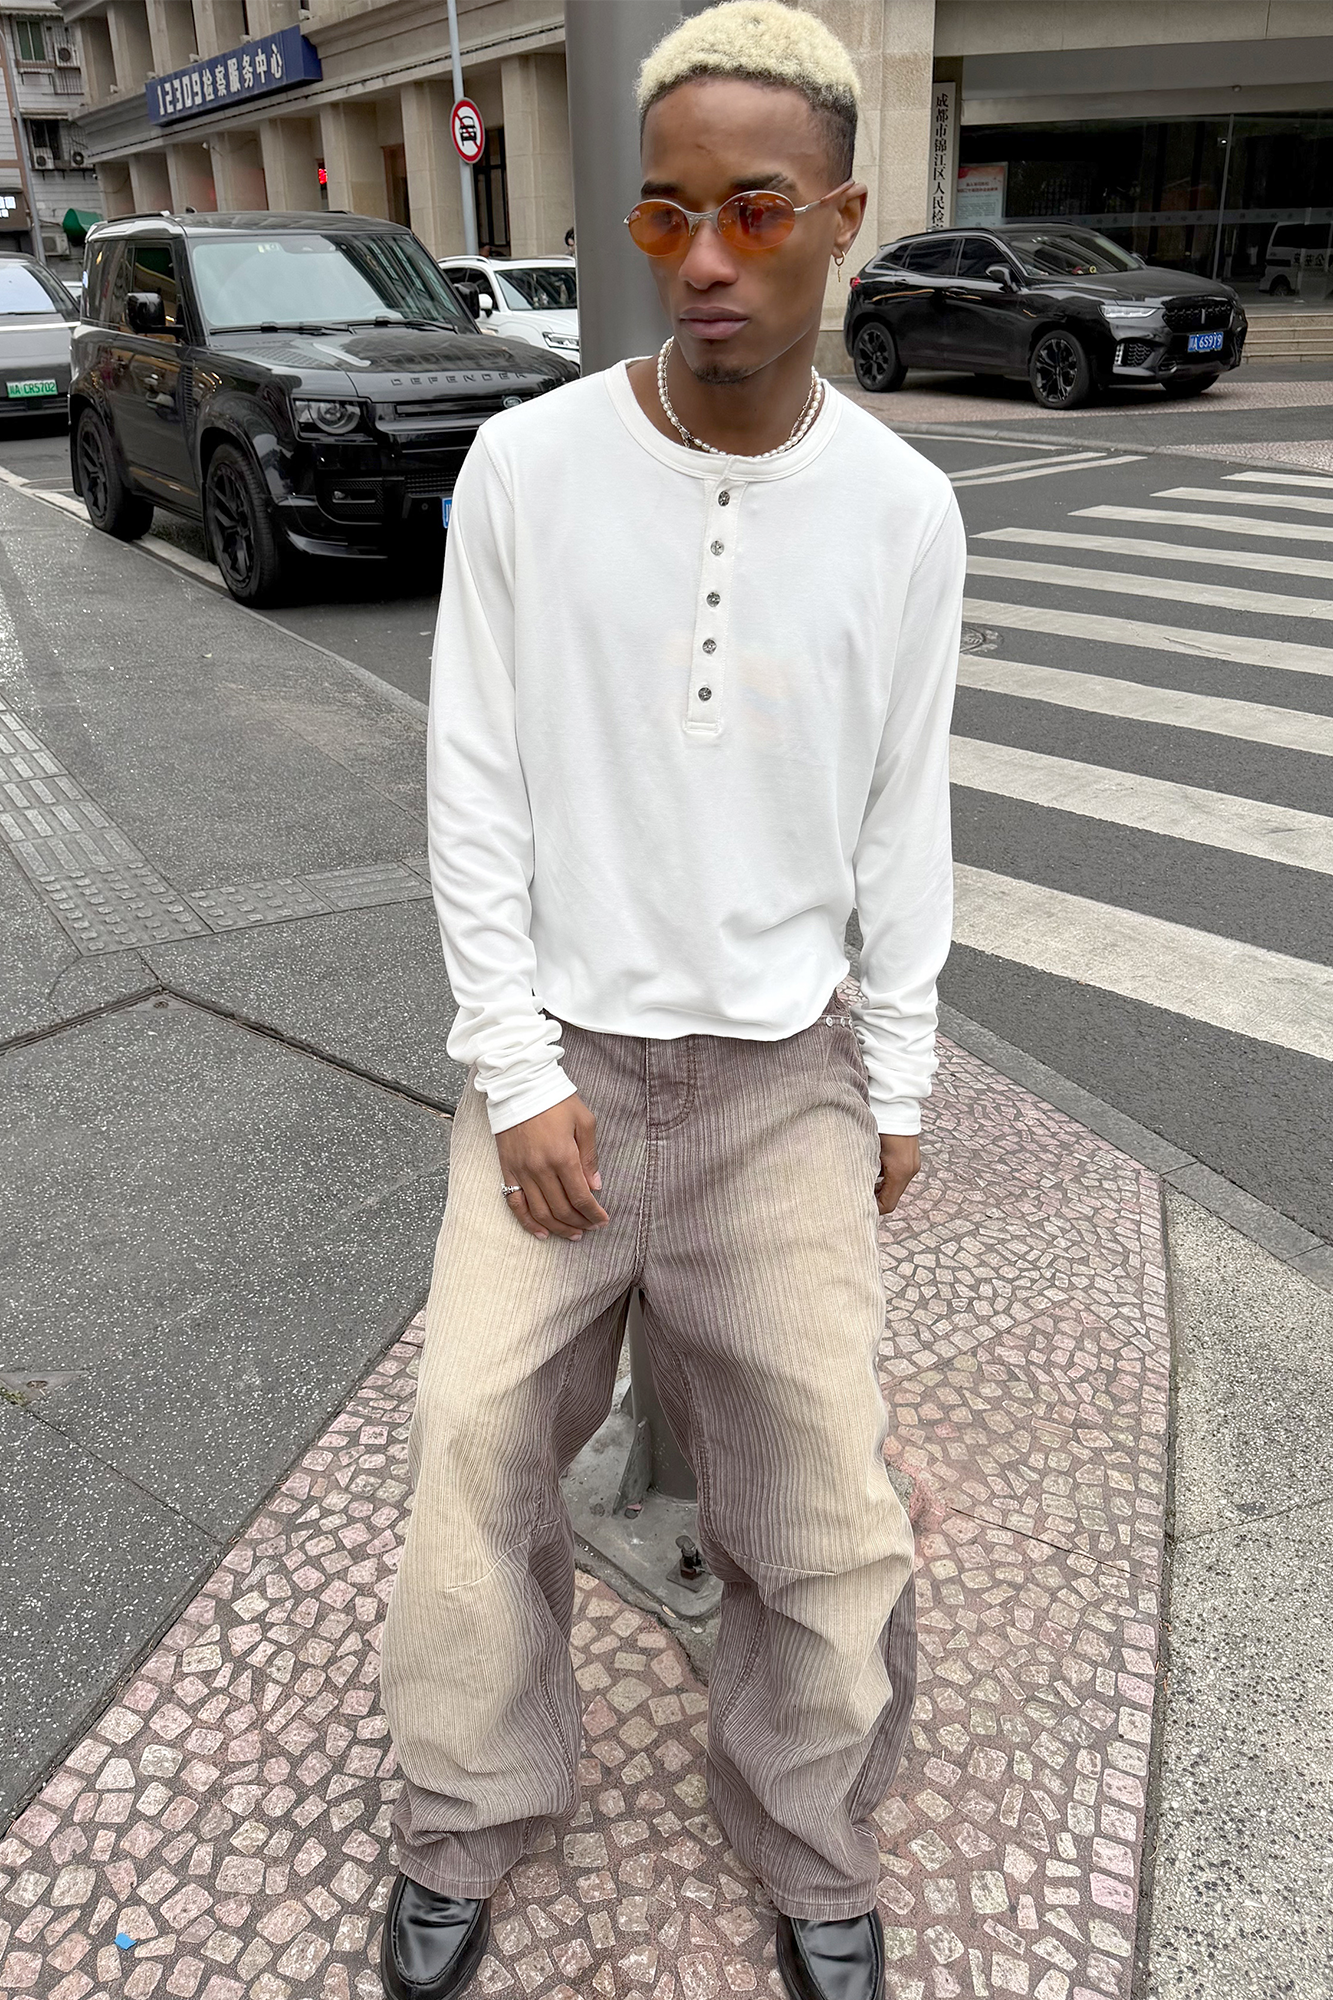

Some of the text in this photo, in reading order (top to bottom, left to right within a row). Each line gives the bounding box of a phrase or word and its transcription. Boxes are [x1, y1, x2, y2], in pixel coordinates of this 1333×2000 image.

[156, 43, 283, 116] 12309检察服务中心
[391, 372, 527, 386] DEFENDER
[23, 382, 56, 395] CR5702
